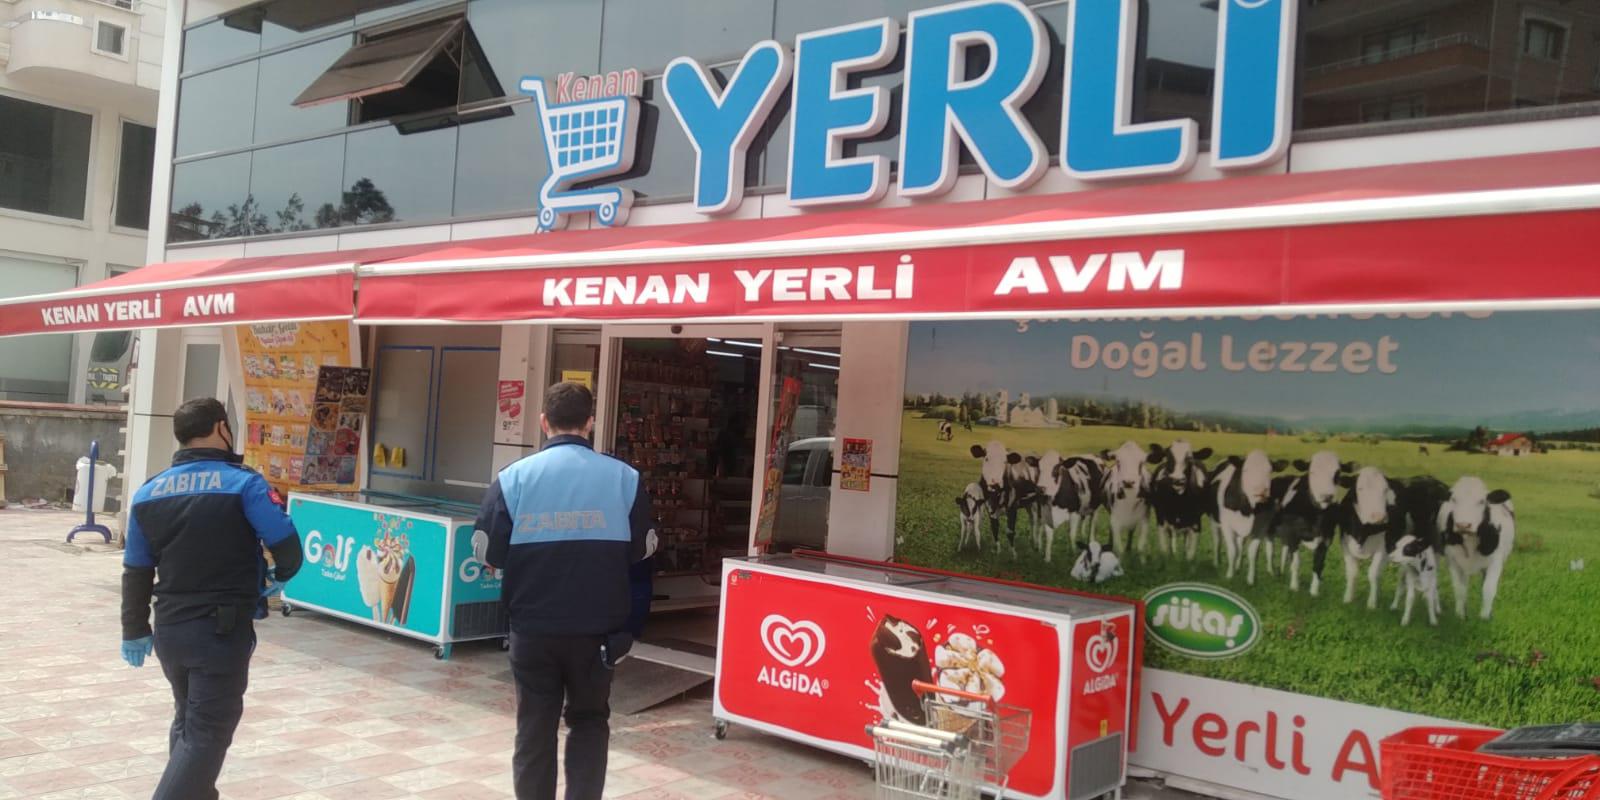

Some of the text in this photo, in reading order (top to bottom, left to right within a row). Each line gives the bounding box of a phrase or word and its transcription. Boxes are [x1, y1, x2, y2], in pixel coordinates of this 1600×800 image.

[556, 68, 638, 104] Kenan
[541, 249, 1185, 306] KENAN YERLİ AVM
[41, 292, 235, 326] KENAN YERLİ AVM
[1070, 329, 1399, 378] Doğal Lezzet
[151, 471, 222, 497] ZABITA
[518, 510, 607, 533] ZABITA
[304, 530, 356, 573] Golf
[1152, 596, 1244, 649] sütaş
[1151, 692, 1311, 776] Yerli
